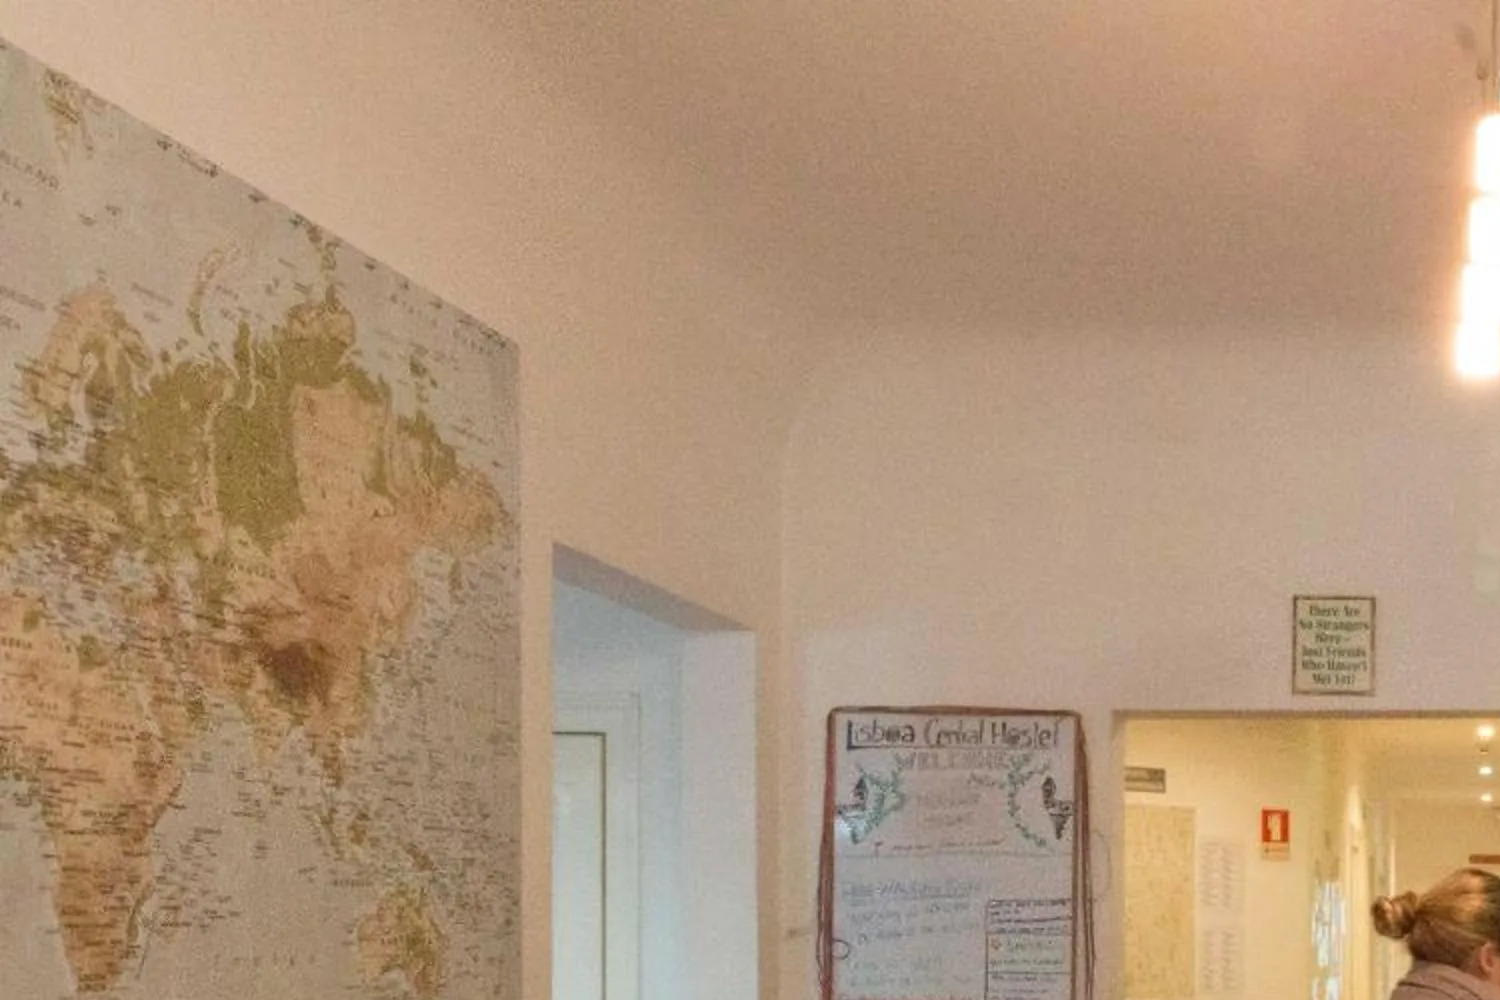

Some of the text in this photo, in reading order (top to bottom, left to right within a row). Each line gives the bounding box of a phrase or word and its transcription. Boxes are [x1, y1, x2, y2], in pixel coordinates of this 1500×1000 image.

[847, 718, 1059, 750] Lisboa Central Hostel
